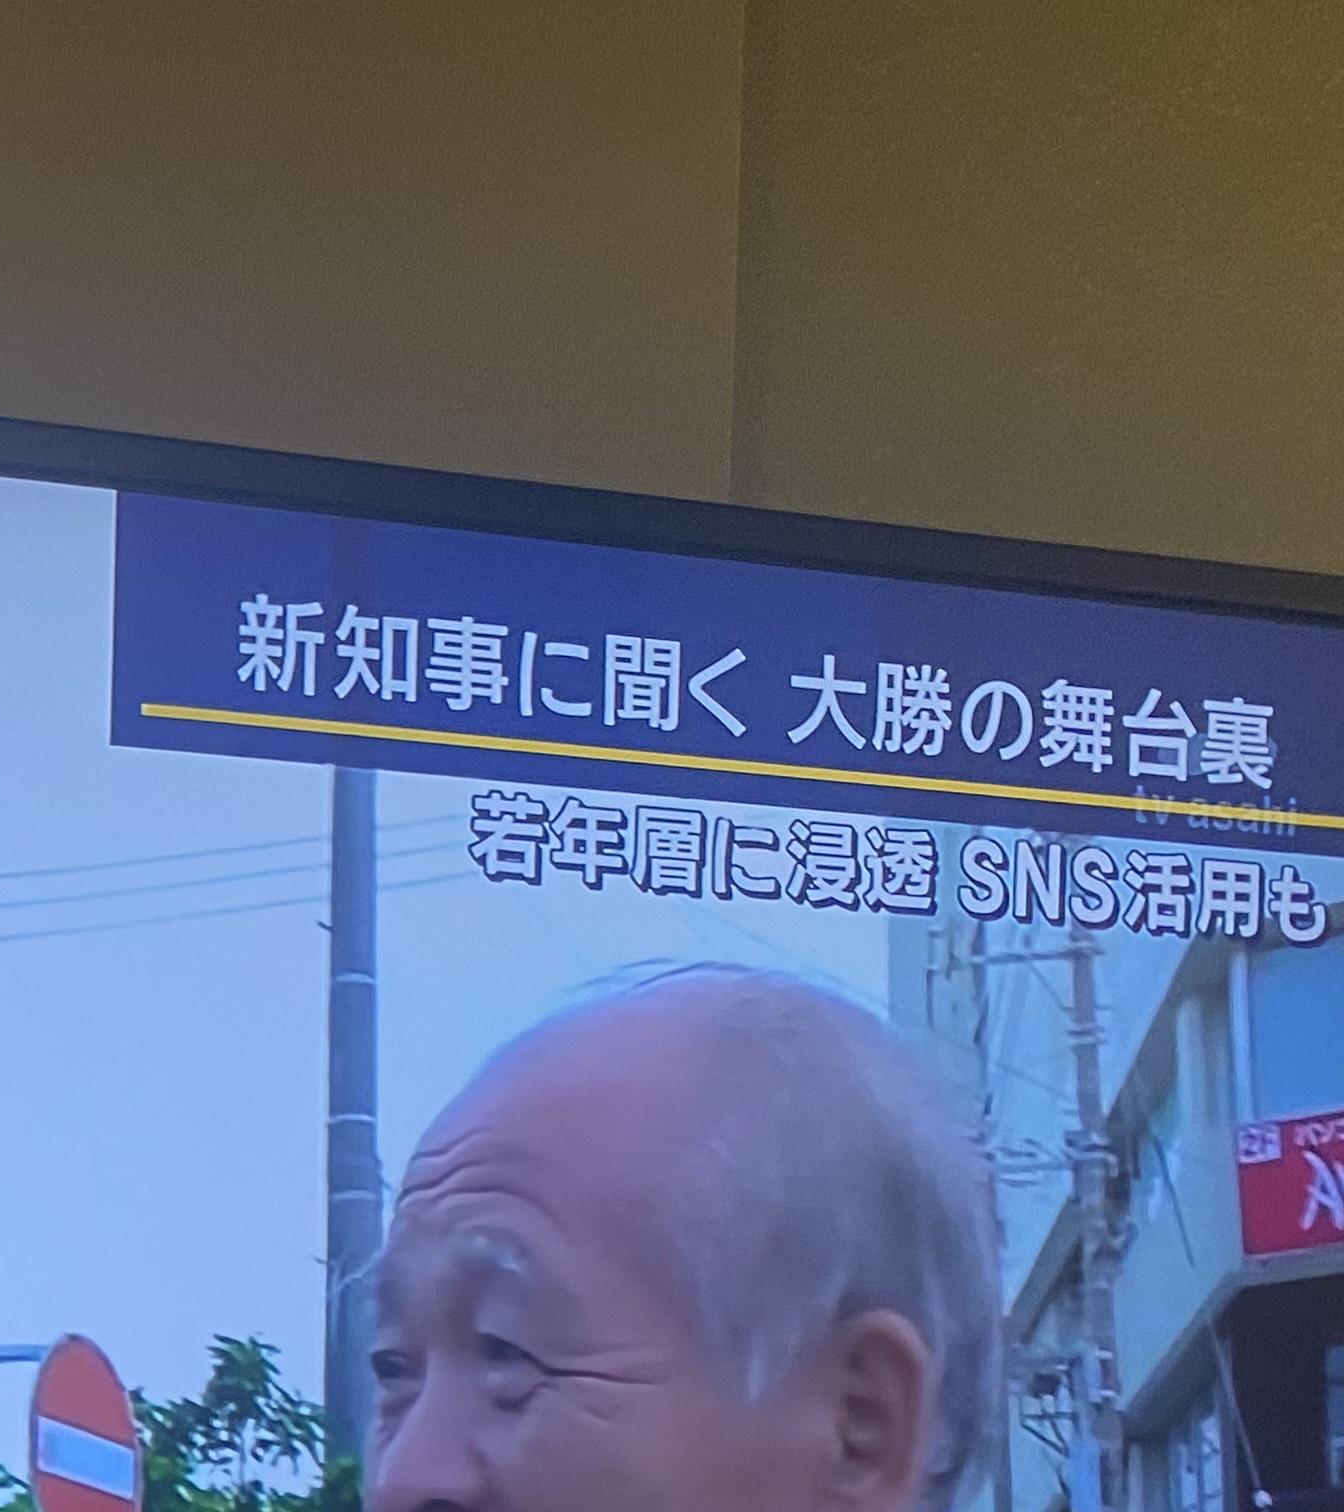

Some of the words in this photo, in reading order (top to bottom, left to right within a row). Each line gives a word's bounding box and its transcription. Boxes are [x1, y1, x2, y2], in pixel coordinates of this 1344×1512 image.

[236, 593, 747, 738] 新知事に聞く
[786, 654, 1276, 790] 大勝の舞台裏
[469, 791, 938, 916] 若年層に浸透
[956, 836, 1330, 946] SNS活用も
